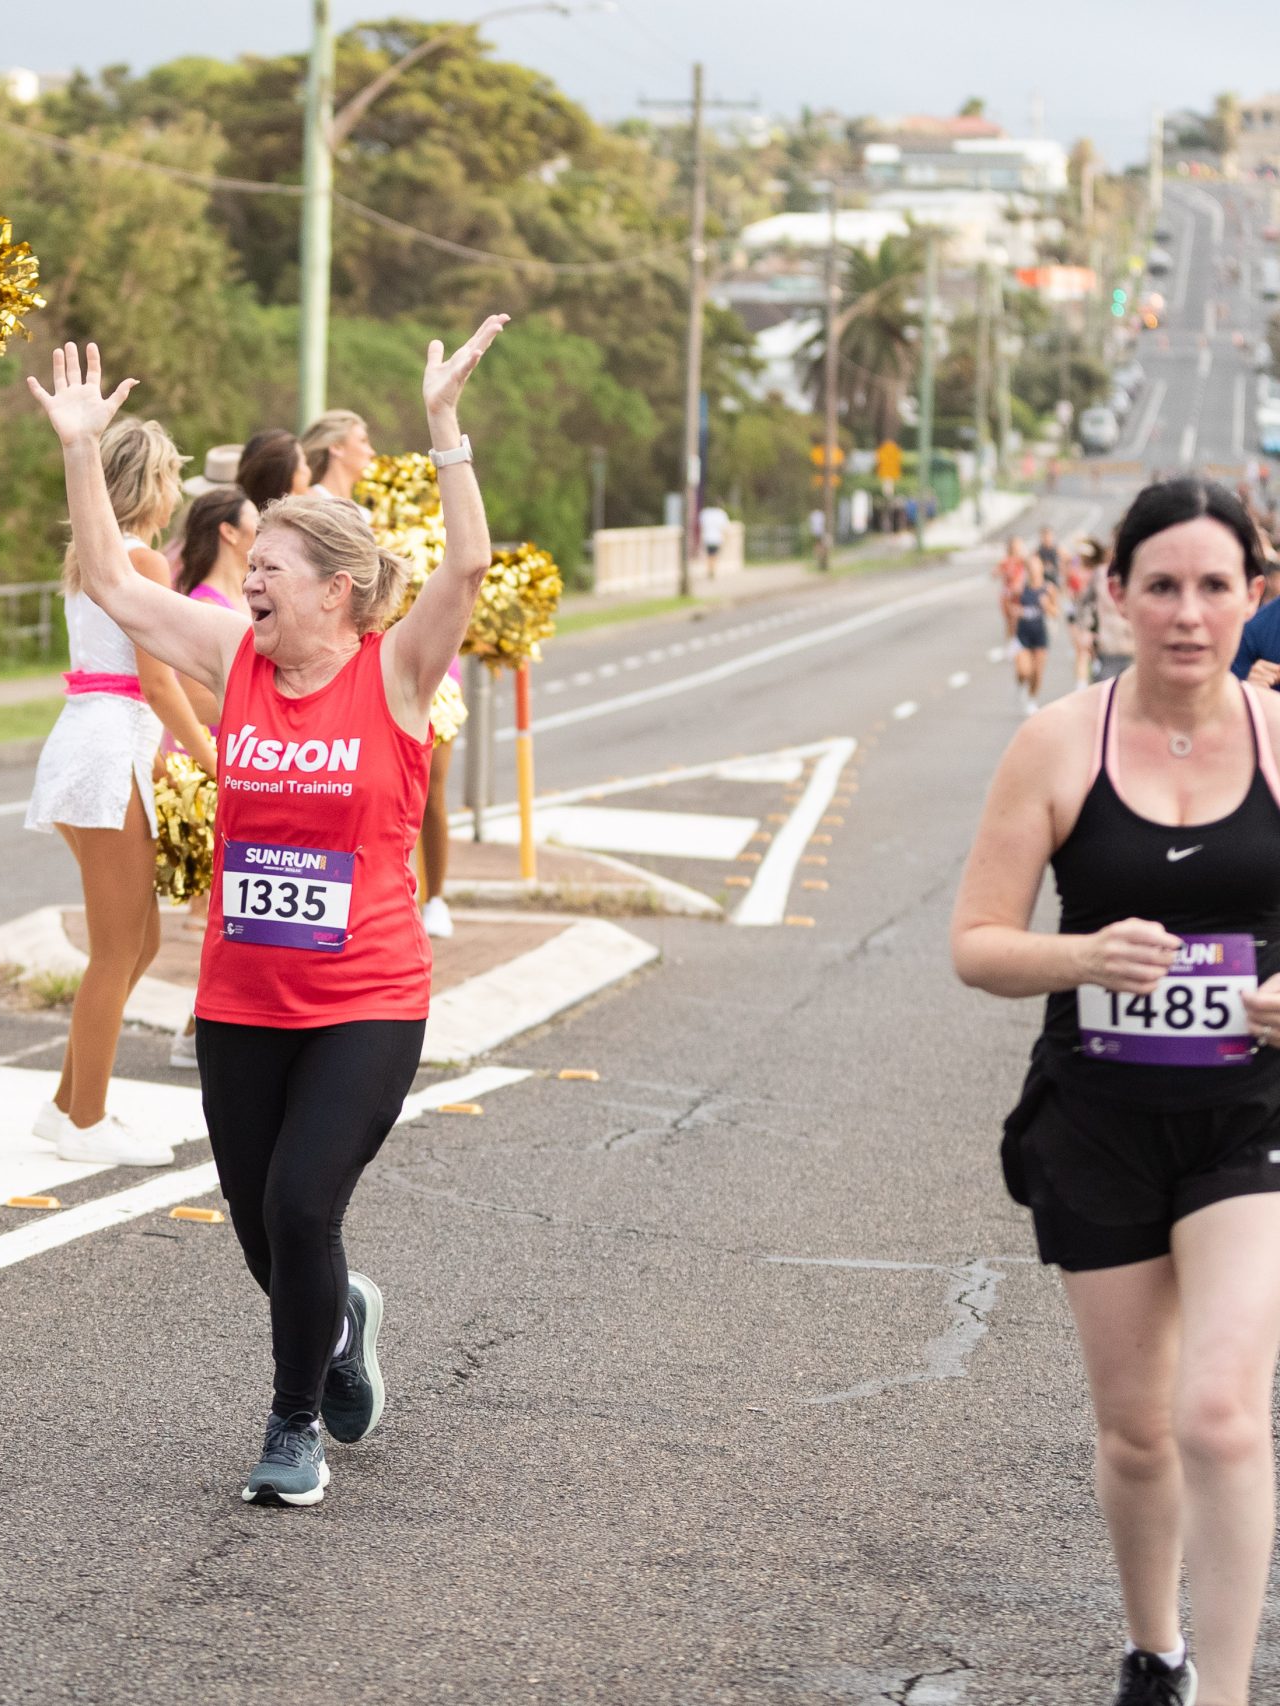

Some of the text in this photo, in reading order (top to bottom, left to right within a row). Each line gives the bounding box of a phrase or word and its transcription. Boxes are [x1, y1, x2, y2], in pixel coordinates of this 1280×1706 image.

[225, 724, 361, 773] VISION
[224, 775, 353, 796] Personal Training
[245, 847, 281, 865] SUN
[281, 850, 320, 869] RUN
[238, 878, 327, 921] 1335
[1105, 985, 1230, 1030] 1485
